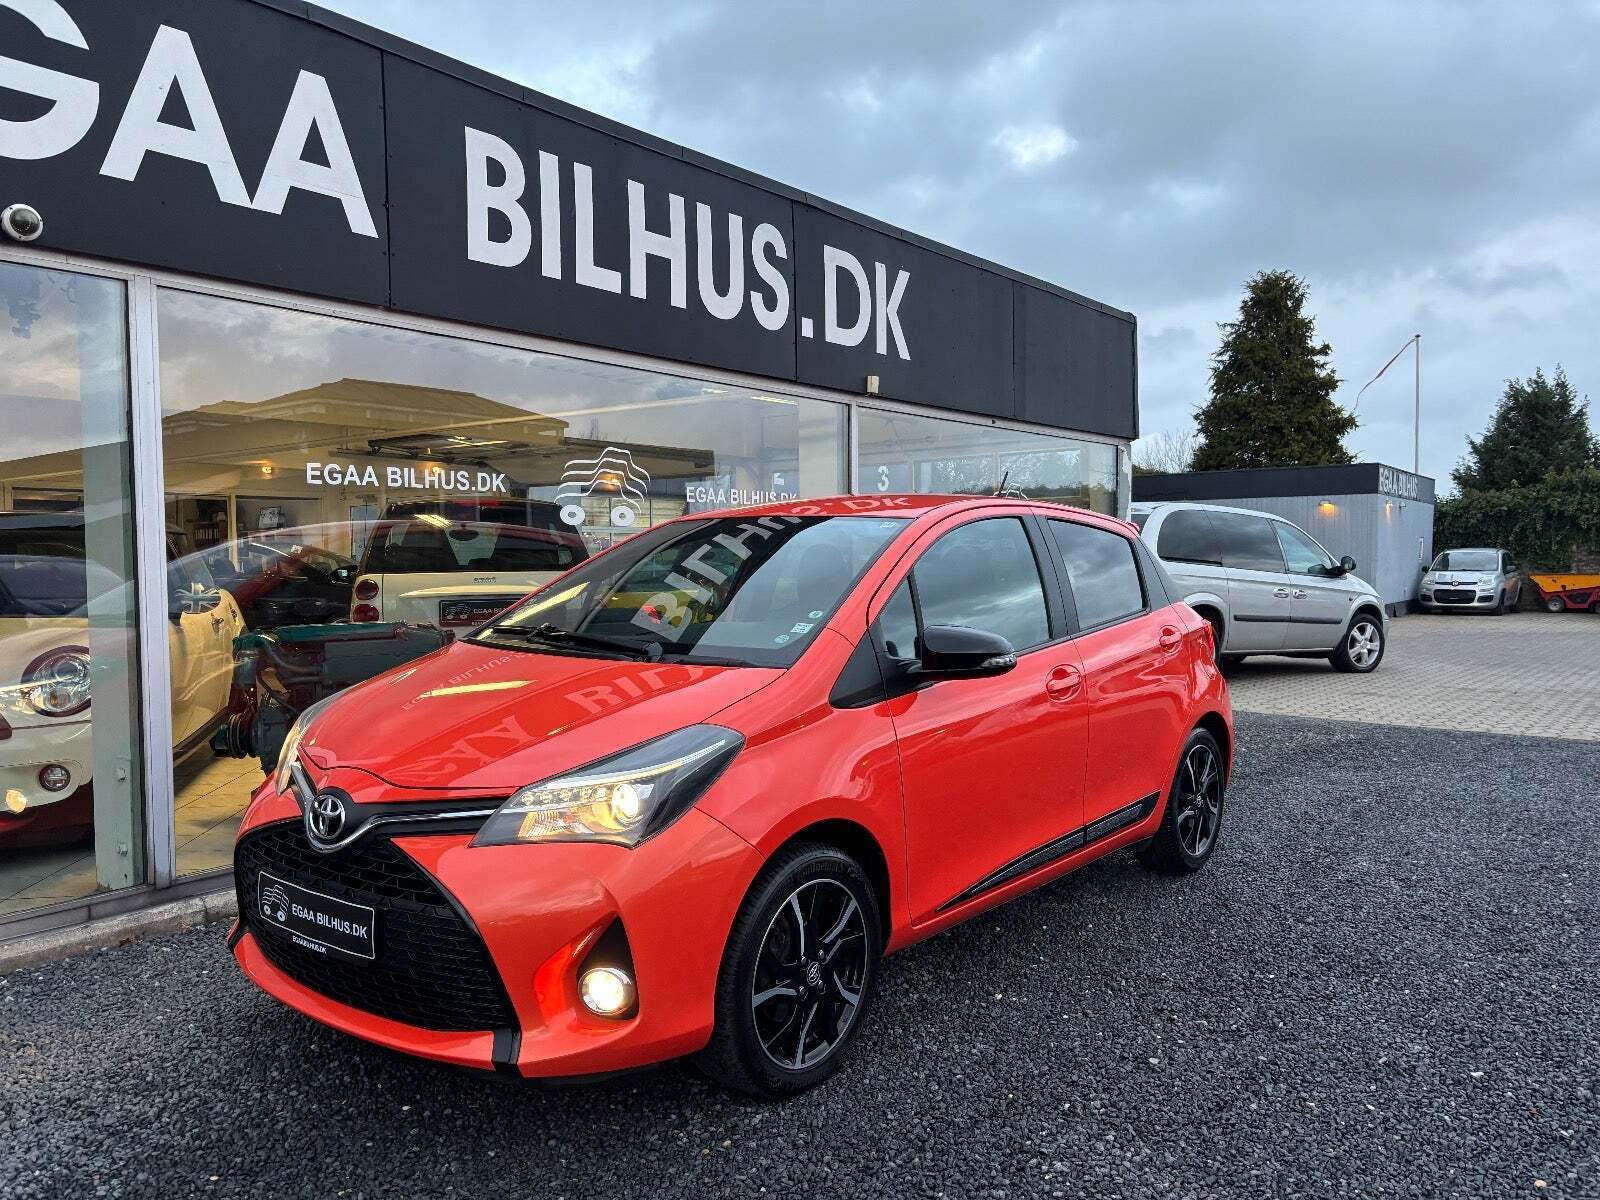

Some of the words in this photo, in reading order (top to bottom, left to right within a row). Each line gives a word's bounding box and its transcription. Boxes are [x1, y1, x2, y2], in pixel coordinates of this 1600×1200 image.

[464, 126, 911, 361] BILHUS.DK
[306, 462, 379, 486] EGAA
[386, 466, 507, 493] BILHUS.DK
[877, 465, 889, 491] 3
[686, 486, 727, 504] EGAA
[291, 903, 315, 923] EGAA
[316, 912, 368, 939] BILHUS.DK
